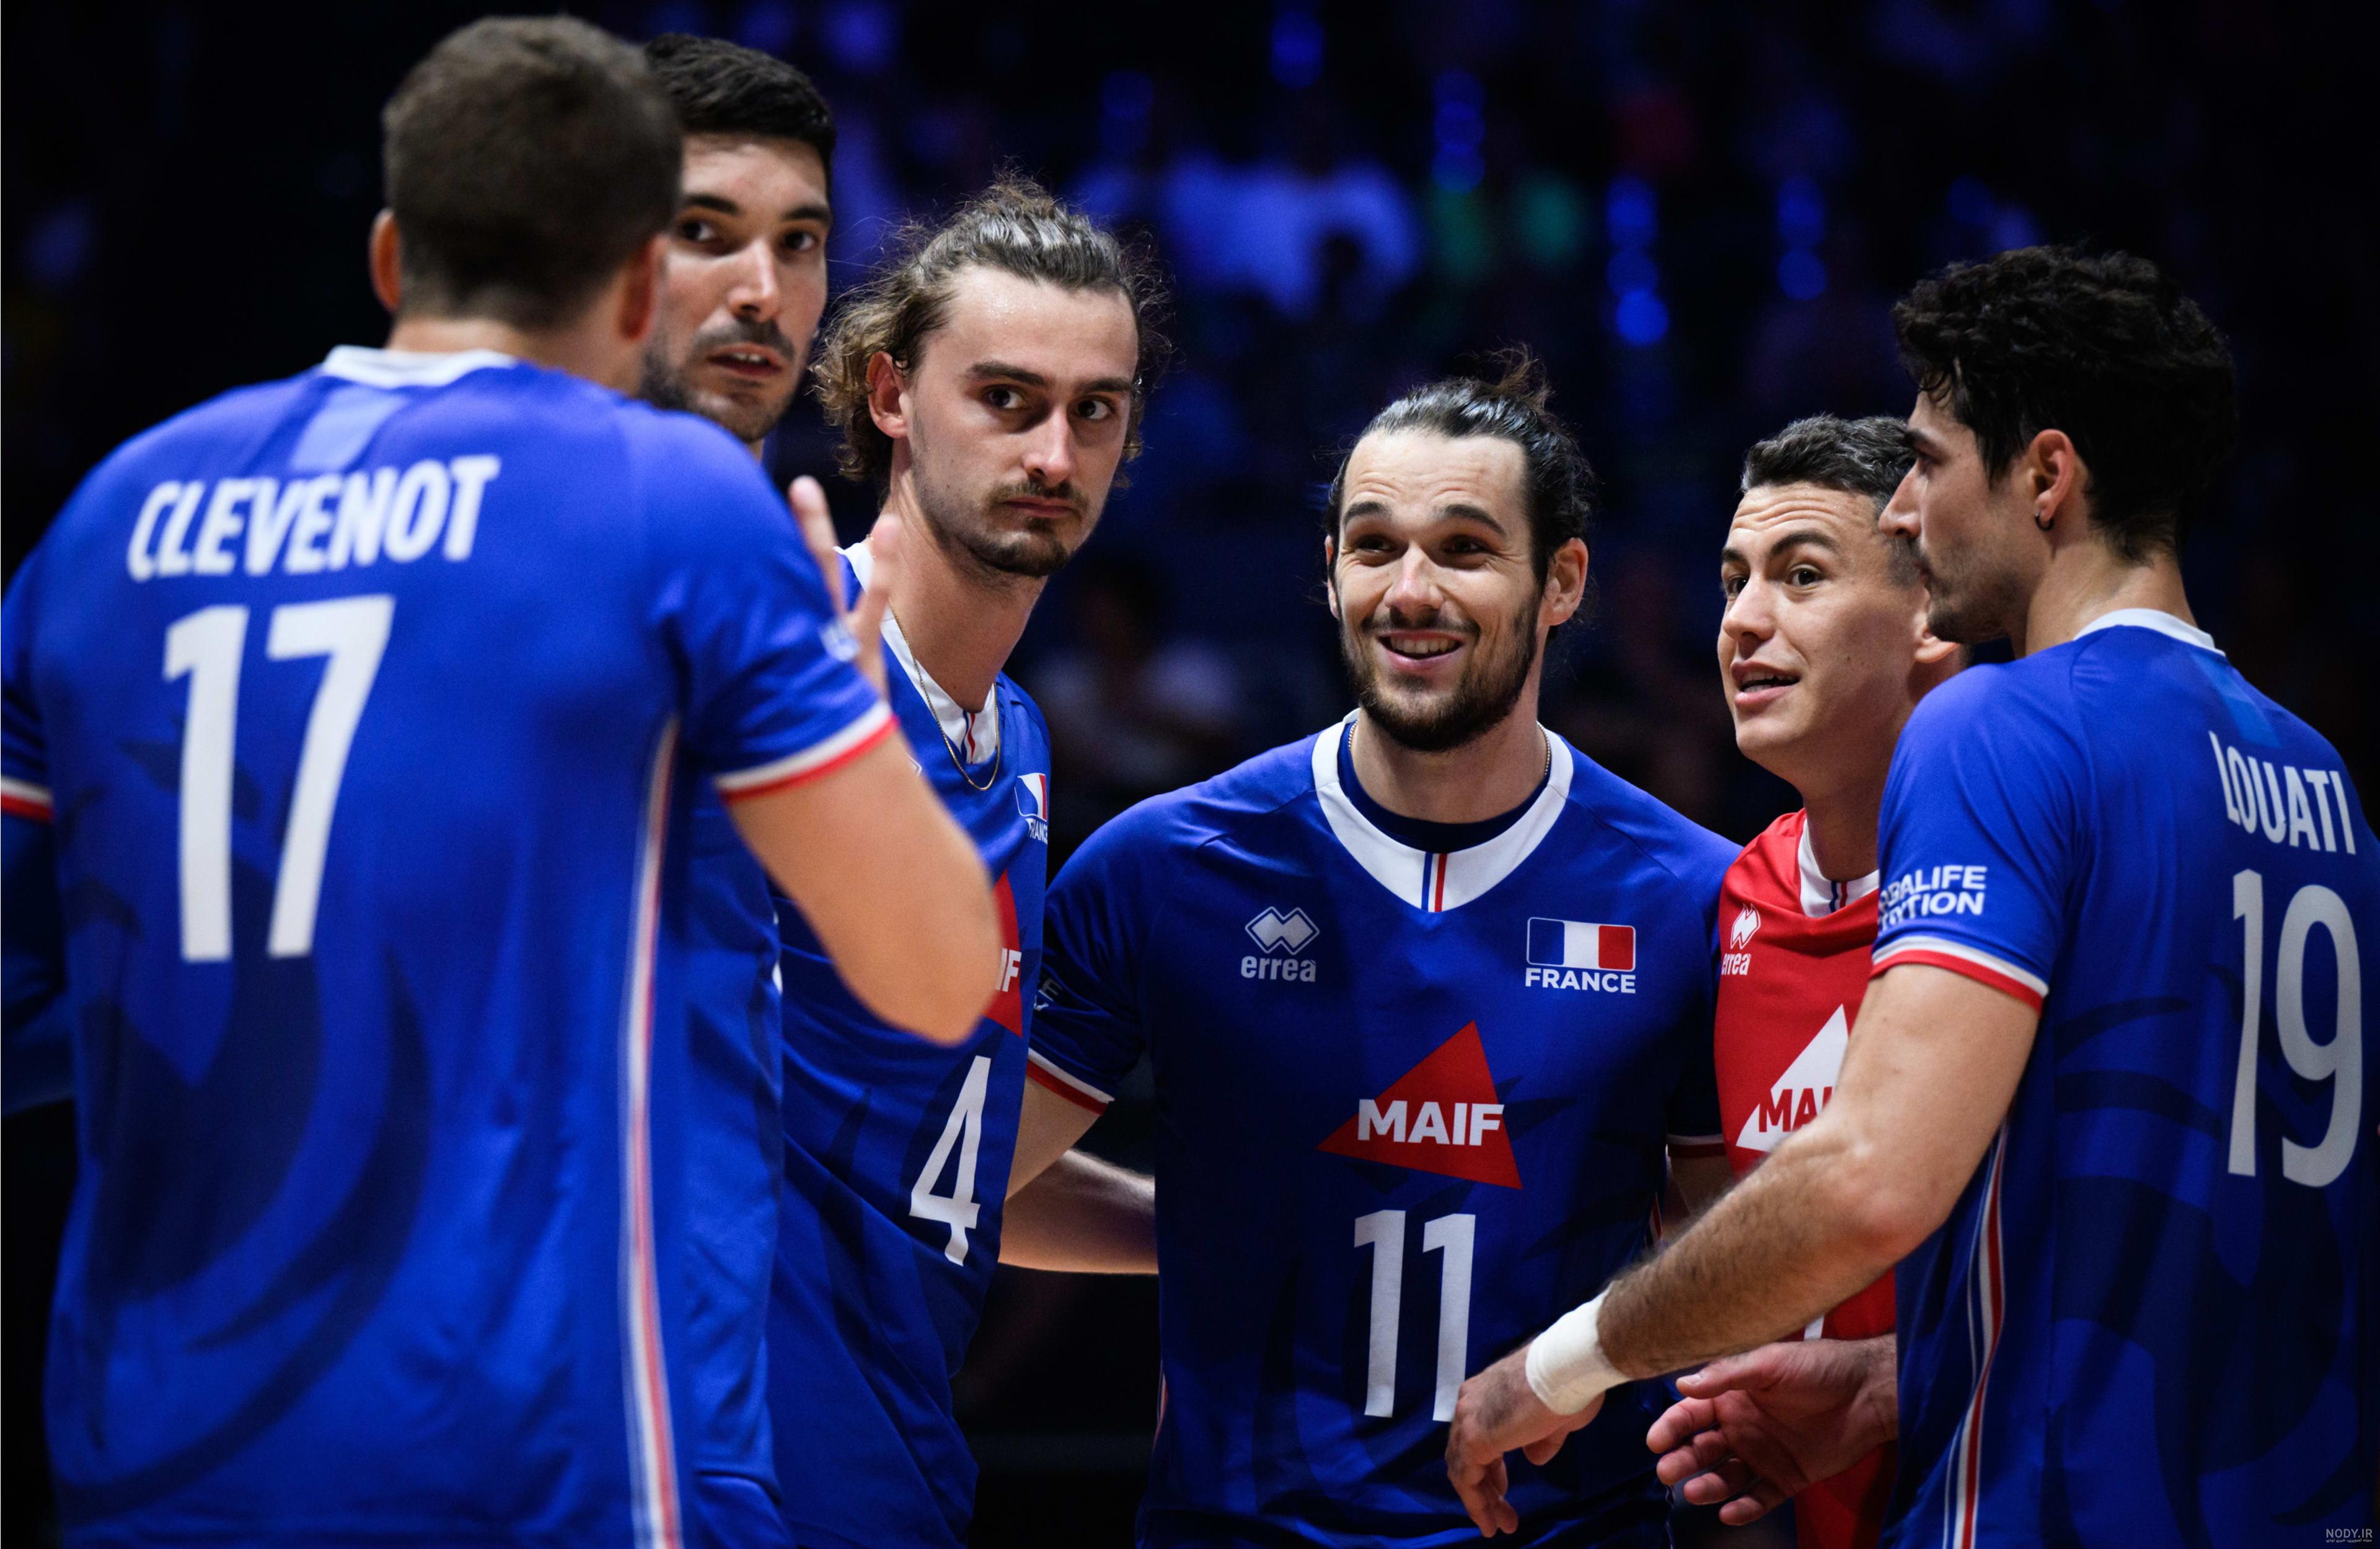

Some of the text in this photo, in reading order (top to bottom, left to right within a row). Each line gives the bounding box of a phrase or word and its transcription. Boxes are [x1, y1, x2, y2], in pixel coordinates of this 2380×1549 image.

[127, 454, 500, 581] CLEVENOT
[162, 593, 395, 963] 17
[2209, 730, 2356, 855] LOUATI
[1525, 968, 1637, 994] FRANCE
[2228, 868, 2362, 1188] 19
[909, 1055, 991, 1266] 4
[1357, 1099, 1504, 1146] MAIF
[1354, 1209, 1476, 1422] 11
